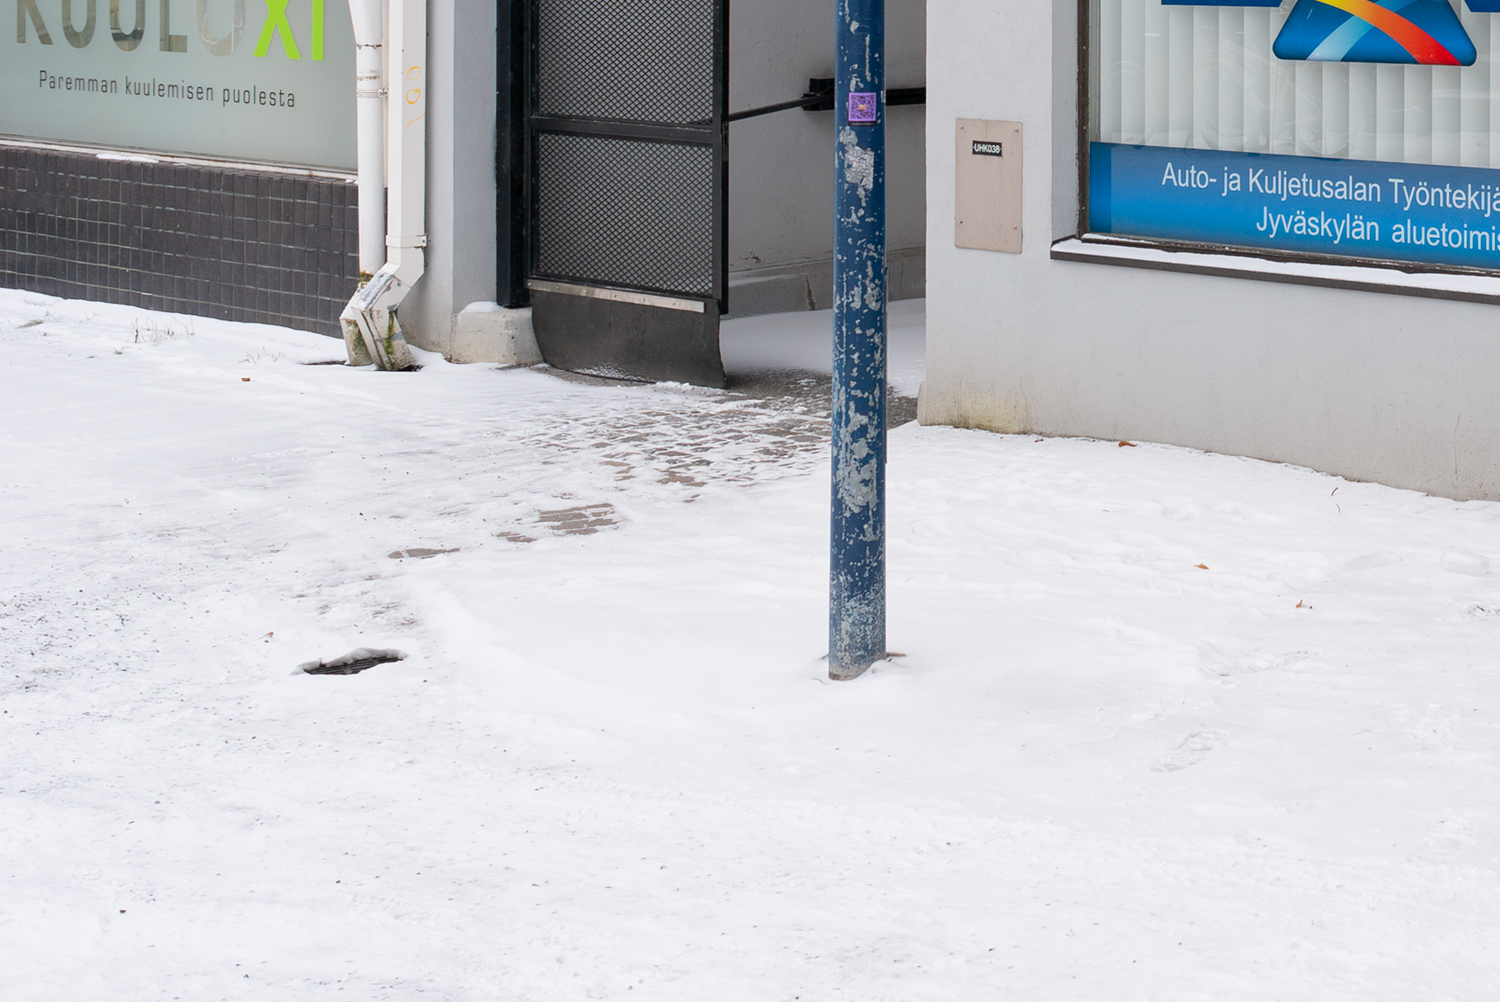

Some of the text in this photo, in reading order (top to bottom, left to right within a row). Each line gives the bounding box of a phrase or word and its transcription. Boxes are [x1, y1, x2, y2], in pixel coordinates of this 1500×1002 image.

[38, 69, 296, 108] Paremman kuulemisen puolesta
[1161, 161, 1217, 190] Auto-
[1222, 165, 1241, 197] ja
[1248, 167, 1381, 202] Kuljetusalan
[1256, 206, 1380, 245] Jyväskylän
